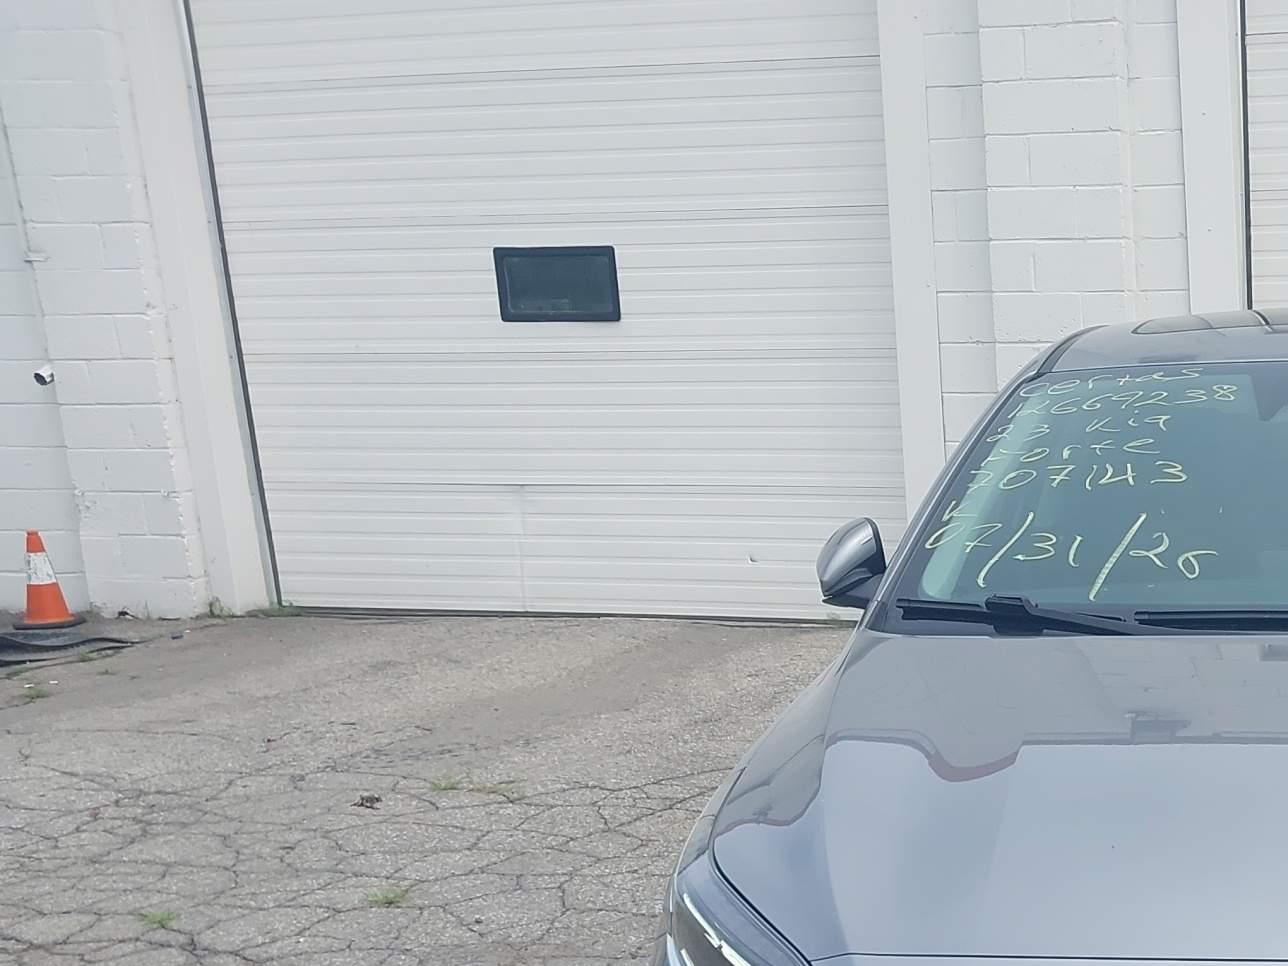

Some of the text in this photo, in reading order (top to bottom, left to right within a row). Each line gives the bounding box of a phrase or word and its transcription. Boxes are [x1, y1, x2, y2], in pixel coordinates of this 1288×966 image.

[1007, 384, 1238, 419] 12669238
[986, 423, 1051, 443] 23
[966, 461, 1188, 494] 707143
